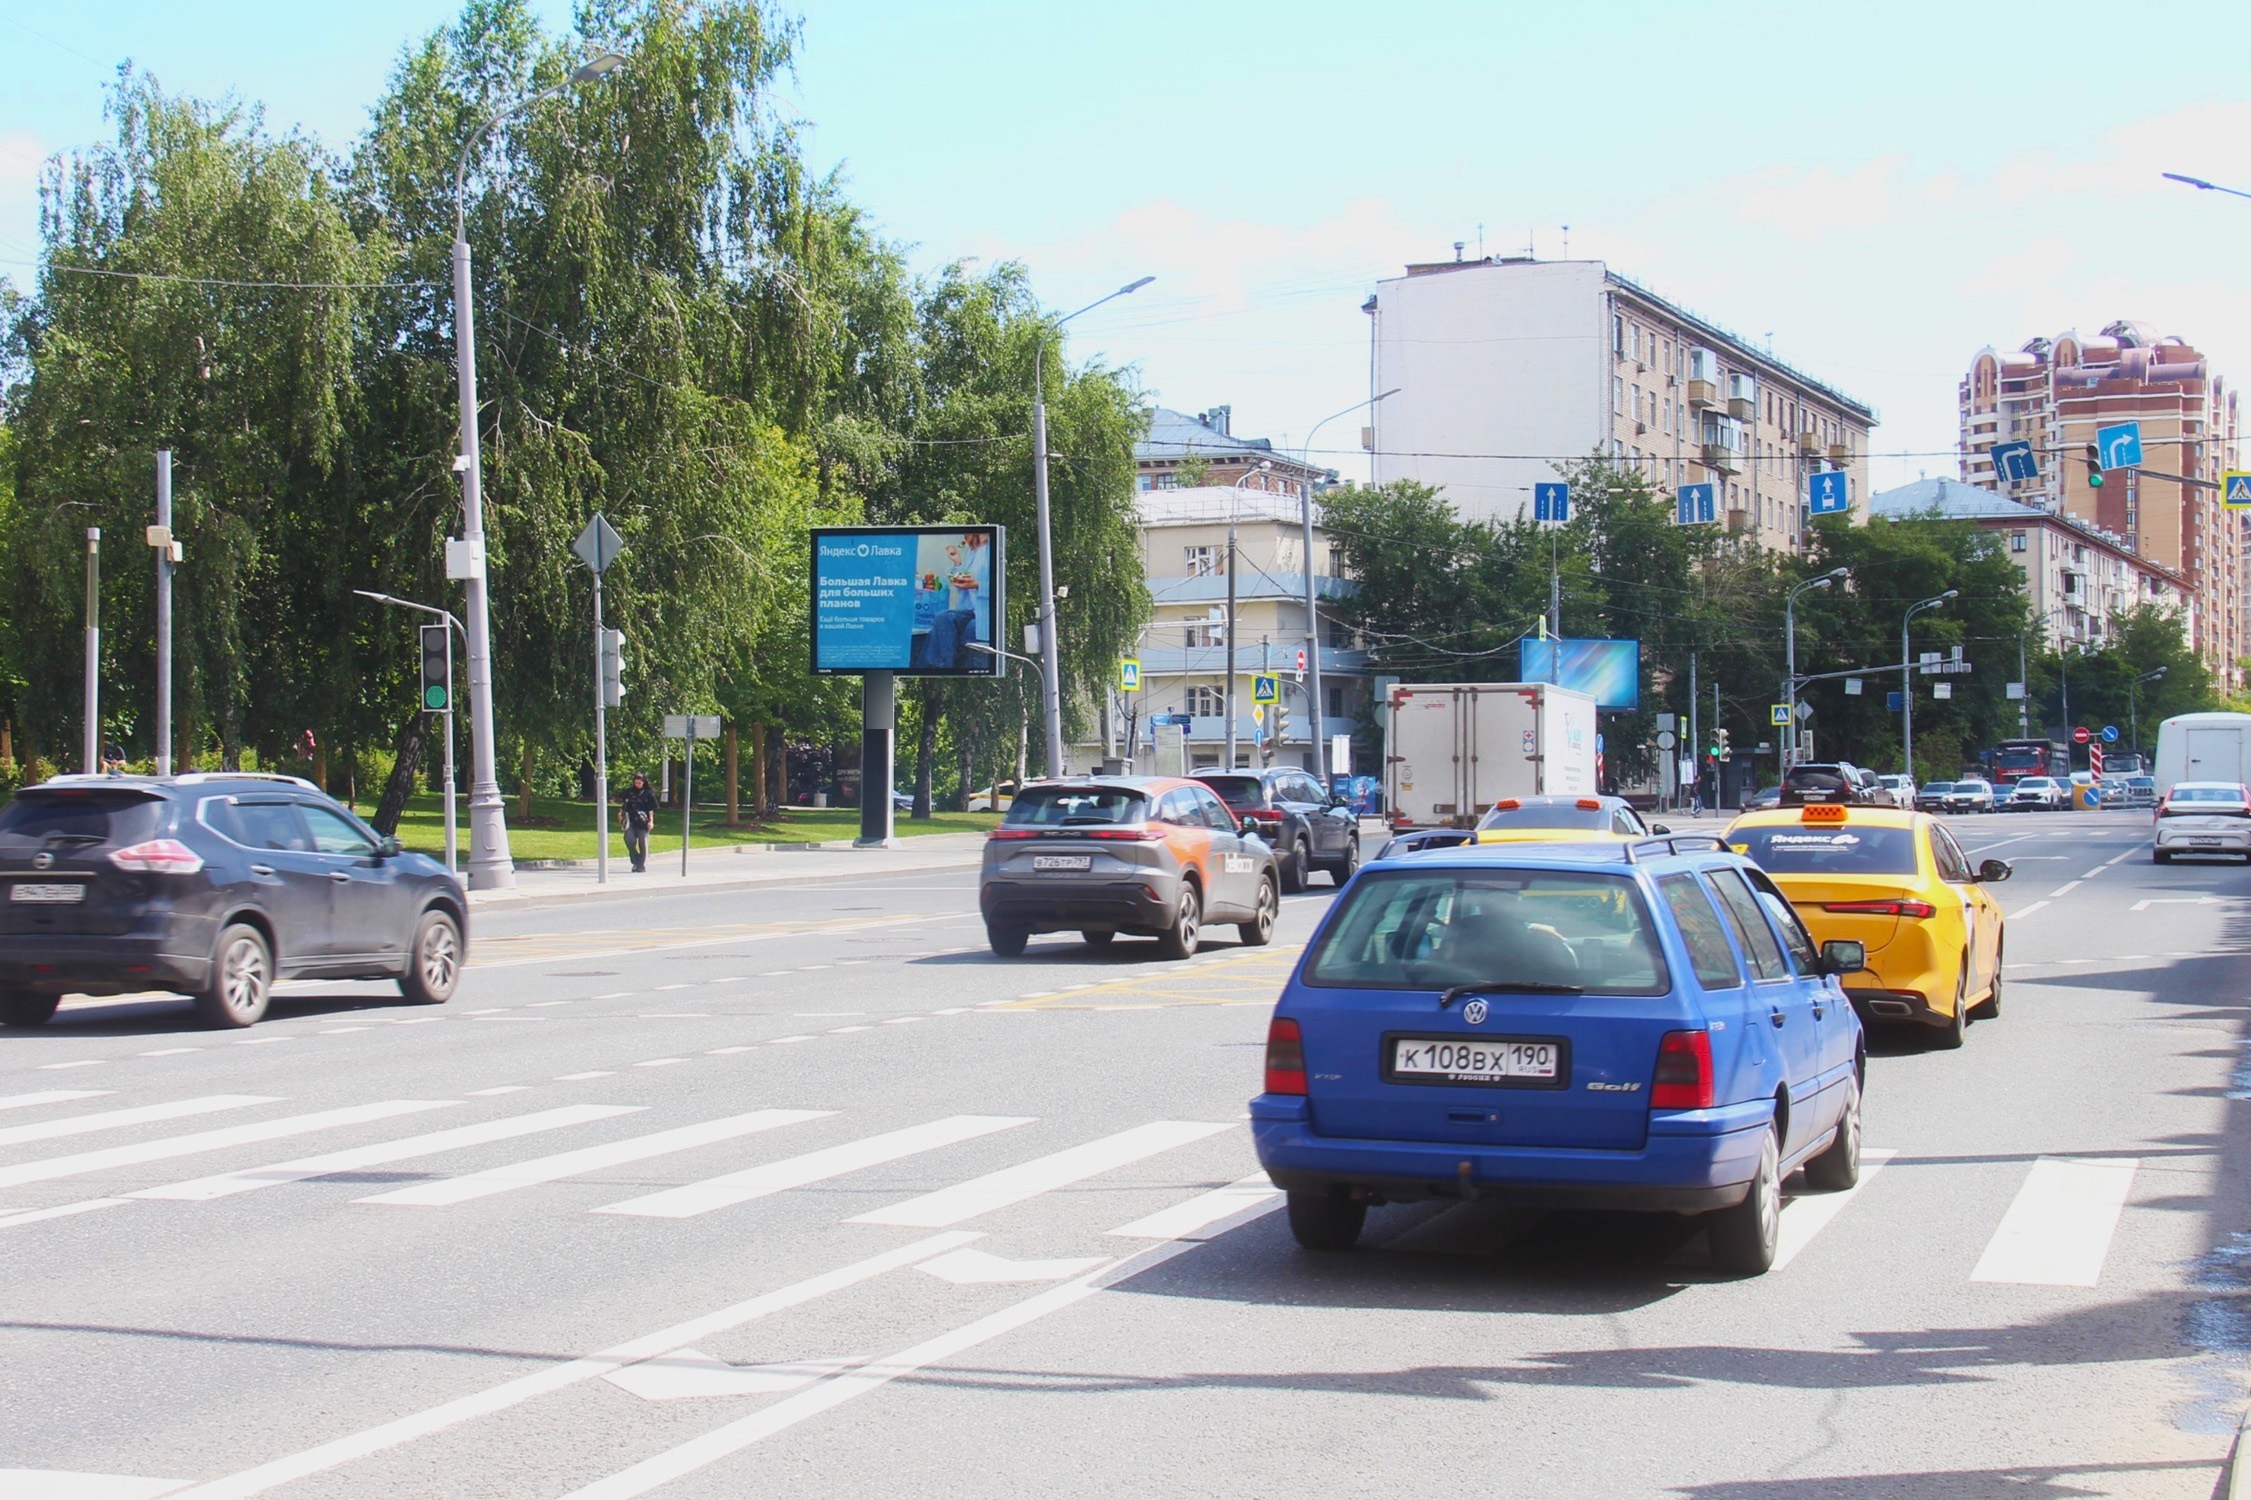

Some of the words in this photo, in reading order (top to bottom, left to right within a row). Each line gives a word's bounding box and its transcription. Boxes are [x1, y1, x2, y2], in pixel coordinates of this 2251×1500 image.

[820, 545, 856, 557] Яндекс
[870, 545, 902, 556] Лавка
[820, 576, 871, 586] Большая
[873, 576, 908, 586] Лавка
[820, 589, 841, 599] для
[843, 587, 894, 597] больших
[820, 600, 861, 608] планов
[1770, 834, 1831, 844] Яндекс
[1512, 1045, 1549, 1065] 190
[1586, 1082, 1641, 1091] Golf
